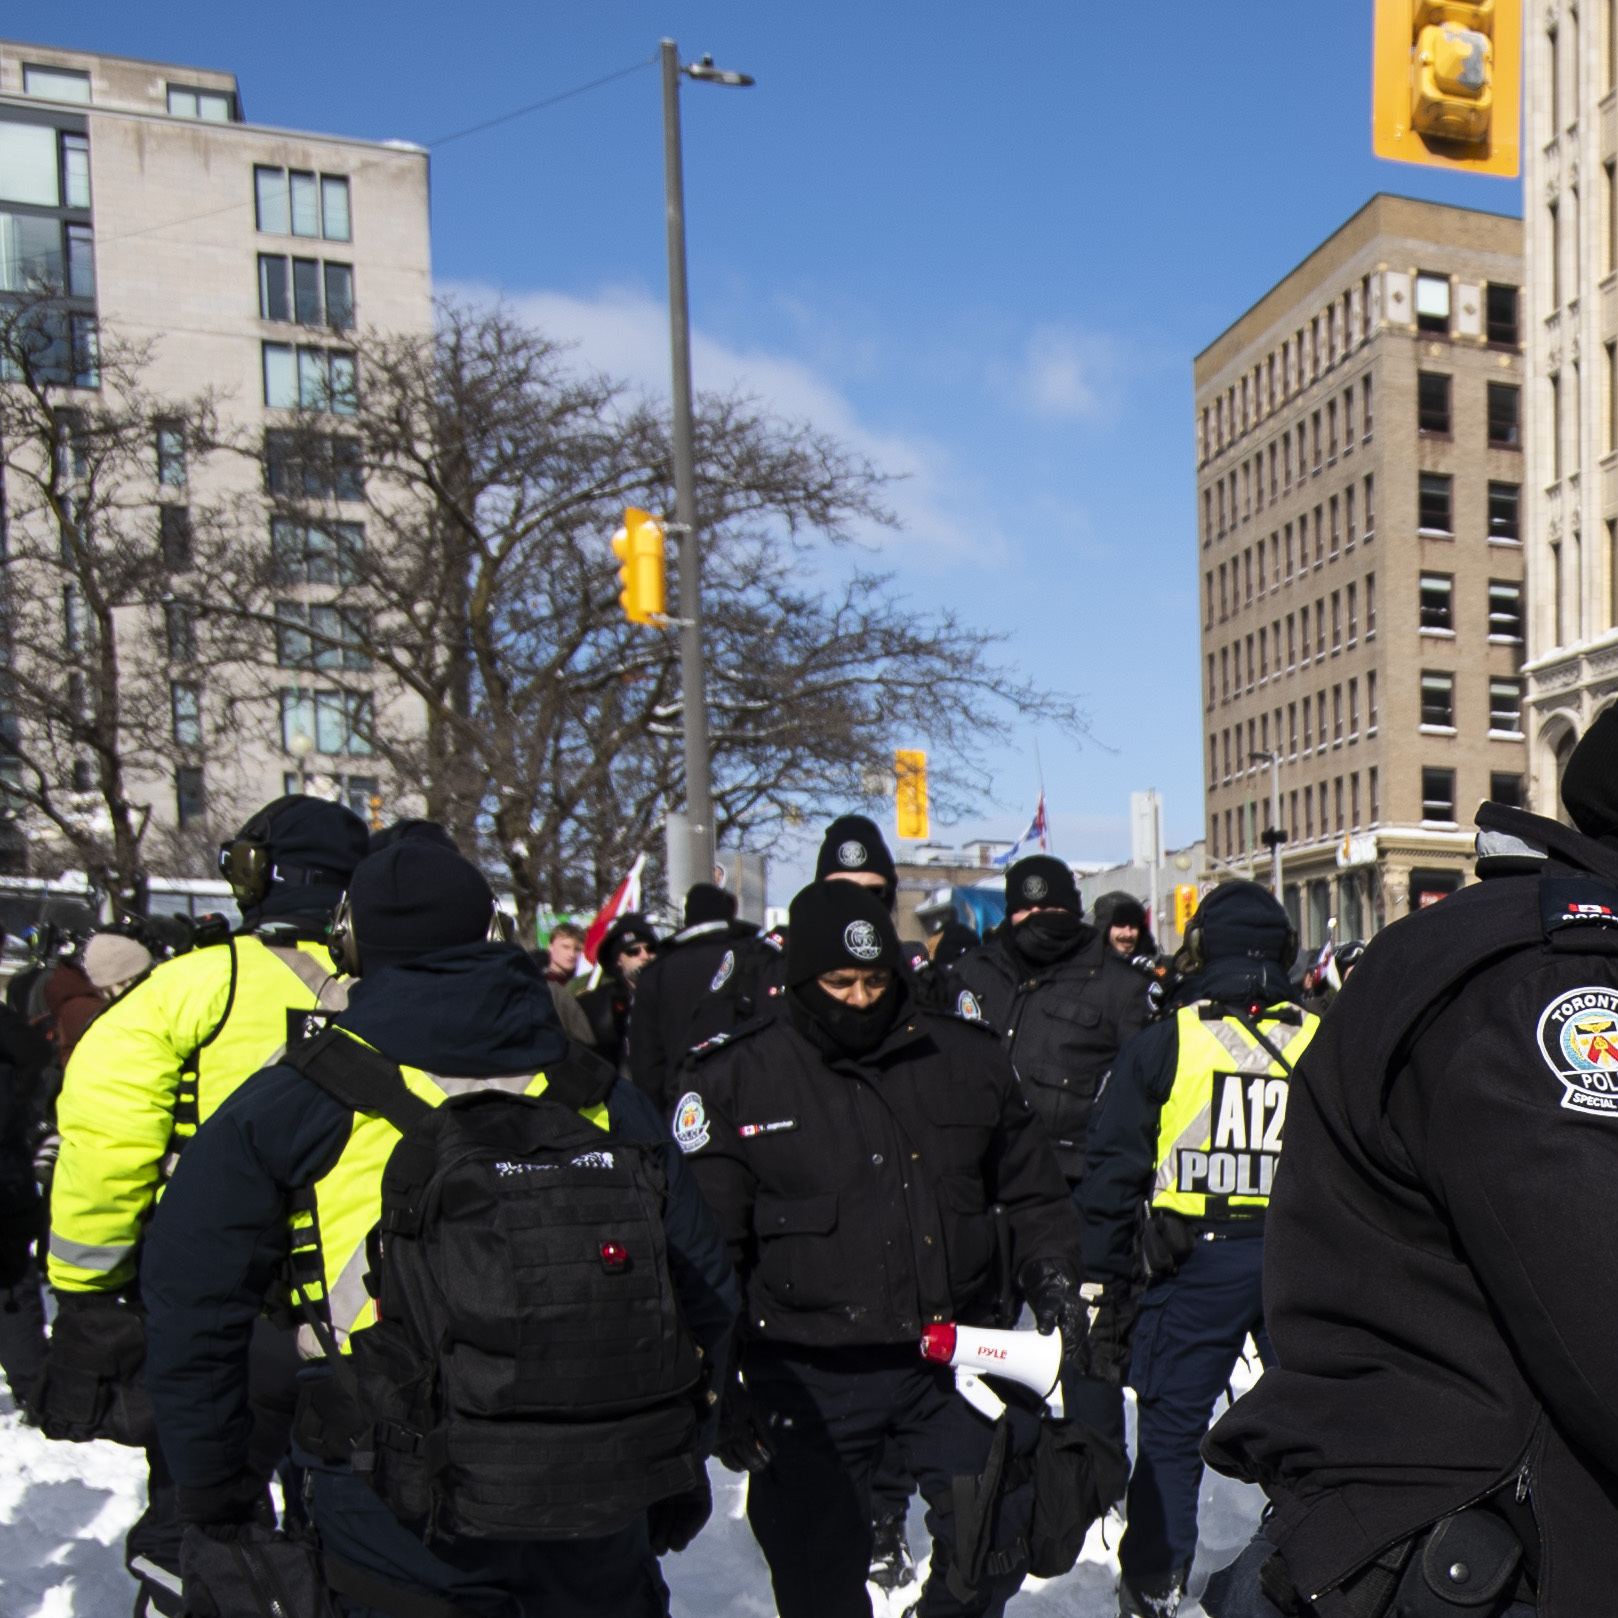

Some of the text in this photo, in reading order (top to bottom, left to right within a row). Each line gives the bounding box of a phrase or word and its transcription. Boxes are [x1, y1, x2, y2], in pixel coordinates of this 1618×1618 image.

[1215, 1076, 1289, 1152] A12
[1572, 1092, 1617, 1109] SPECIAL
[1181, 1151, 1280, 1195] POLI
